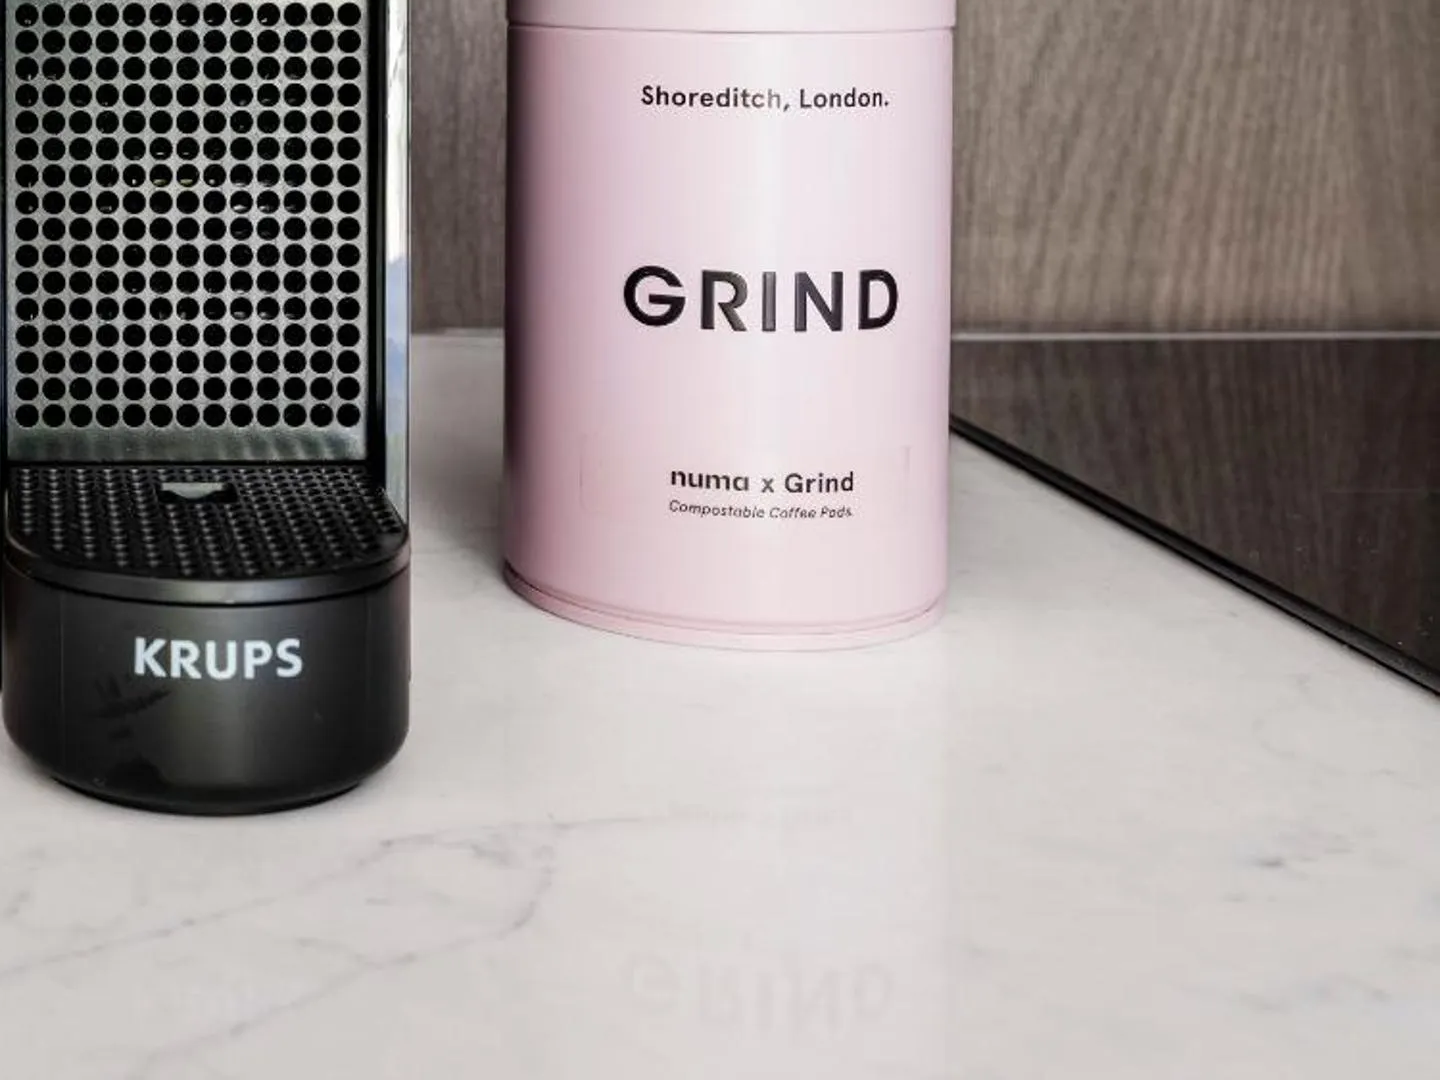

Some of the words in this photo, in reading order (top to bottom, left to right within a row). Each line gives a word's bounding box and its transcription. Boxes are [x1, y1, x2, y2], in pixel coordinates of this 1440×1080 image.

[641, 85, 791, 112] Shoreditch,
[799, 87, 890, 109] London.
[623, 265, 899, 332] GRIND
[670, 470, 750, 491] numa
[761, 478, 775, 493] x
[784, 471, 855, 494] Grind
[669, 499, 765, 519] Compostable
[769, 506, 817, 519] Coffee
[134, 637, 304, 680] KRUPS
